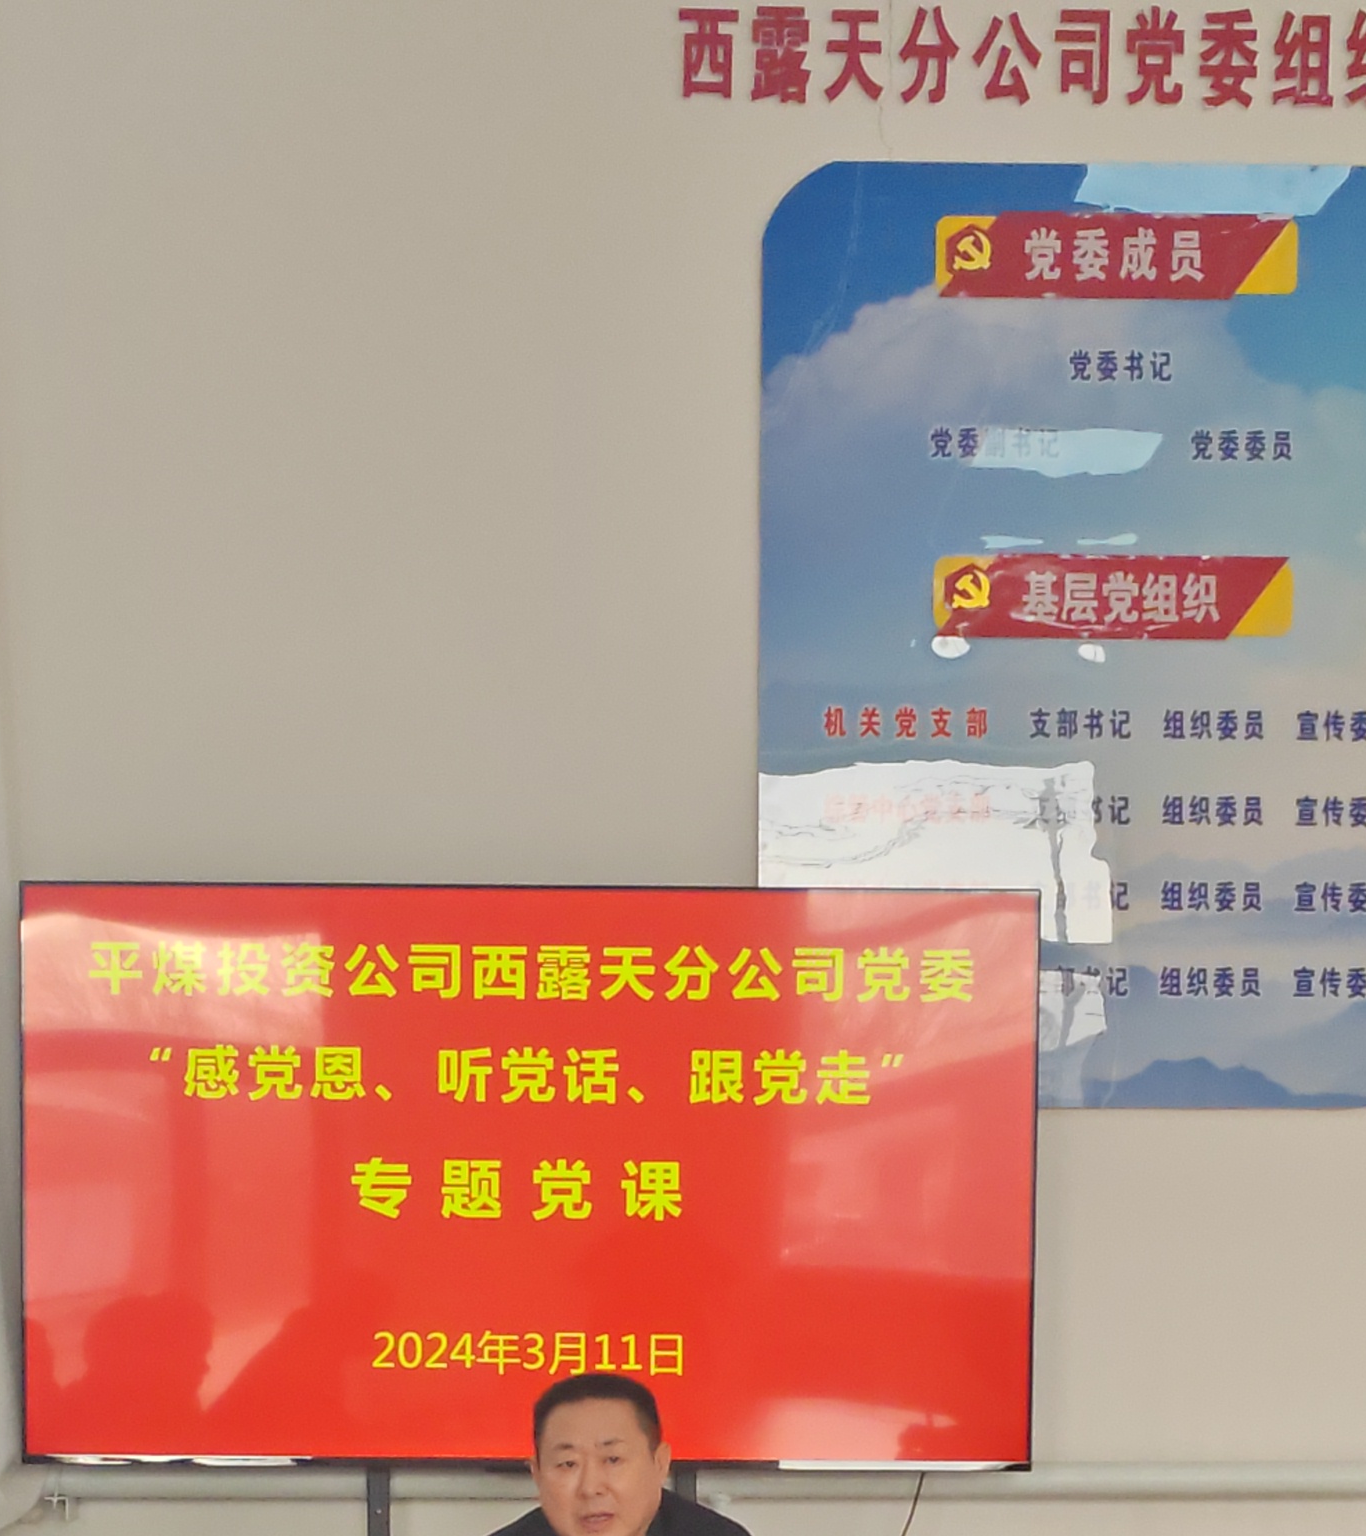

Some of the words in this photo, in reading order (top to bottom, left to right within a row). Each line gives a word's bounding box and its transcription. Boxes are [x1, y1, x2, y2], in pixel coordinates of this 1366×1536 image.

[1023, 228, 1206, 283] 党委成员
[1068, 351, 1174, 382] 党委书记
[1190, 428, 1294, 462] 党委委员
[1021, 571, 1219, 622] 基层党组织
[823, 706, 989, 740] 机关党支部
[1029, 708, 1132, 741] 支部书记
[1162, 710, 1265, 743] 组织委员
[1161, 796, 1265, 829] 组织委员
[1160, 881, 1263, 914] 组织委员
[87, 938, 977, 1004] 平煤投资公司西露天分公司党委
[1159, 966, 1262, 1000] 组织委员
[149, 1044, 907, 1107] “感党恩、听党话、跟党走”
[350, 1156, 685, 1222] 专题党课
[371, 1332, 685, 1377] 2024年3月11日
